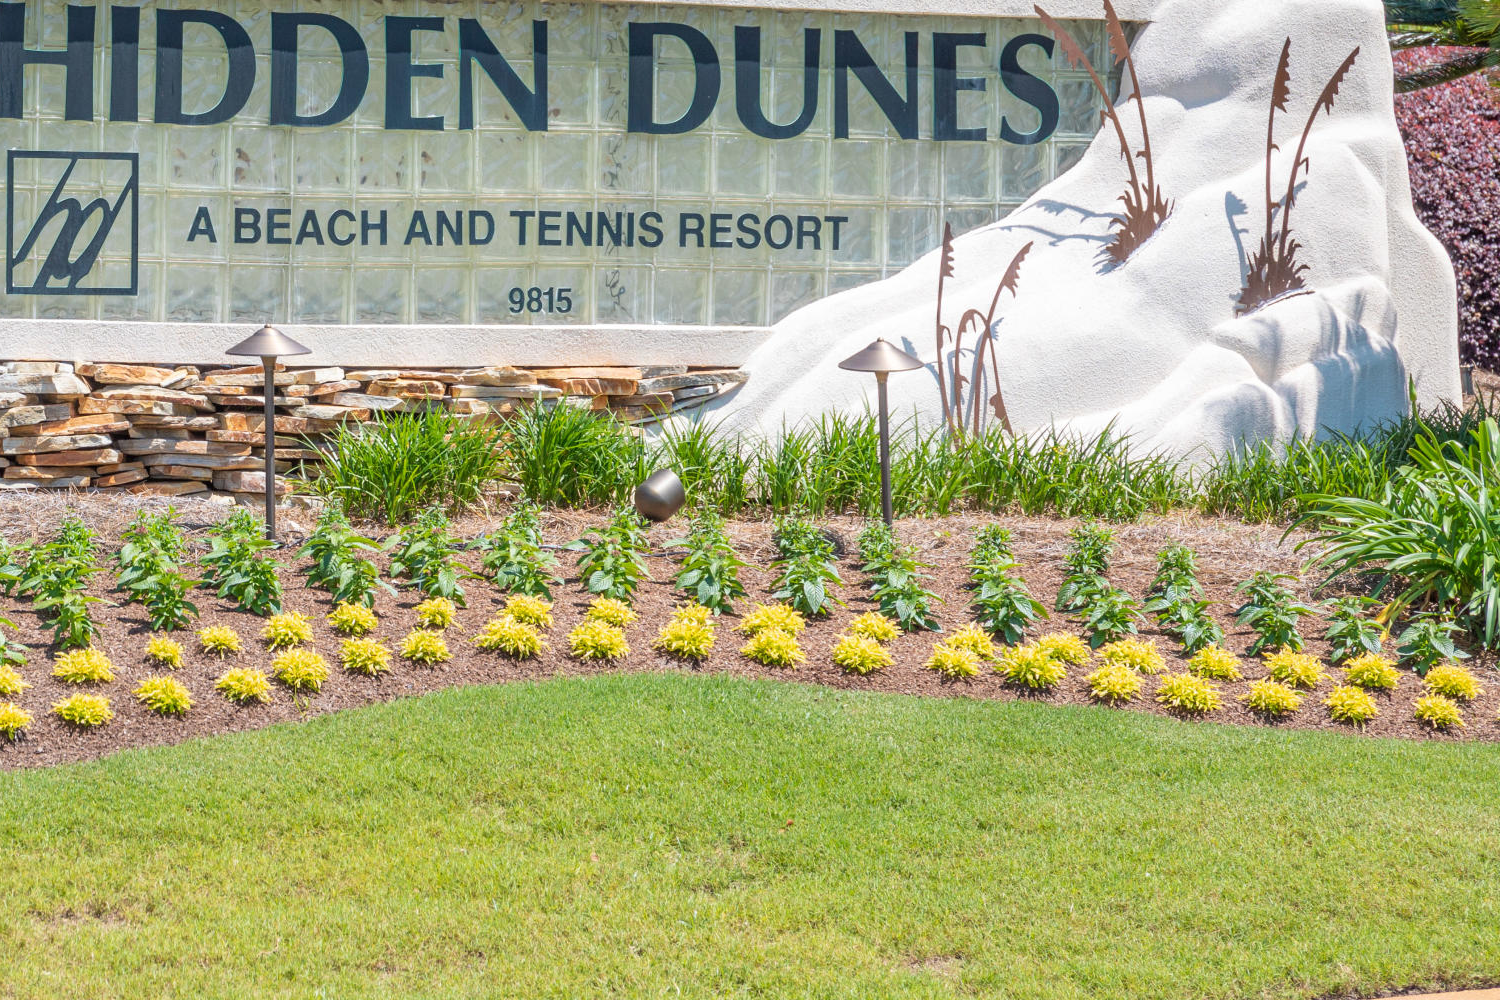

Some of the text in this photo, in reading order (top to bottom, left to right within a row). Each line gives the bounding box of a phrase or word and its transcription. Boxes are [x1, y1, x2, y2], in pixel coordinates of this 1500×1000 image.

[626, 20, 1061, 145] DUNES
[186, 206, 849, 252] A BEACH AND TENNIS RESORT
[508, 286, 573, 314] 9815
